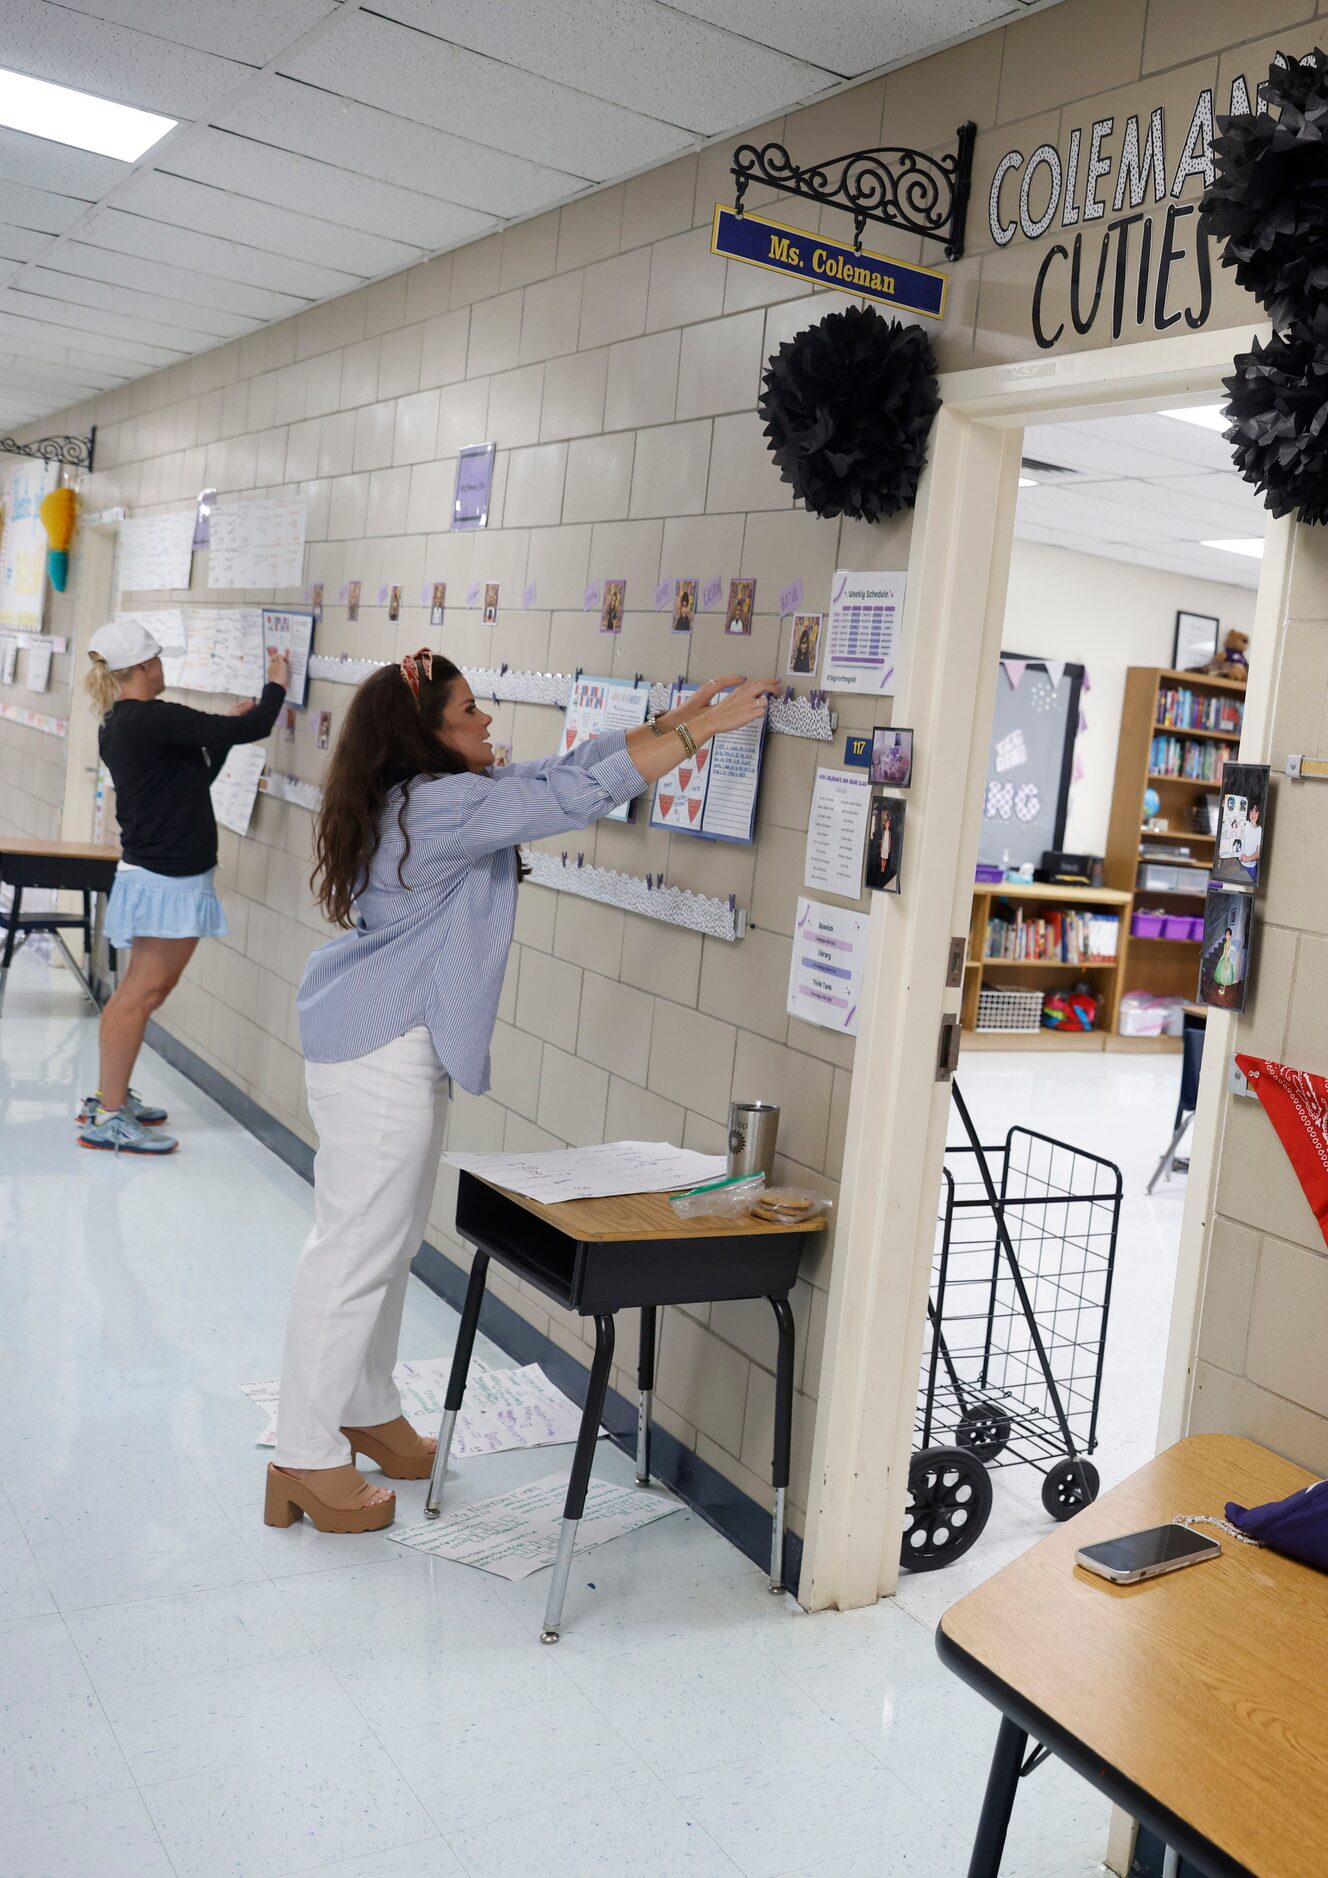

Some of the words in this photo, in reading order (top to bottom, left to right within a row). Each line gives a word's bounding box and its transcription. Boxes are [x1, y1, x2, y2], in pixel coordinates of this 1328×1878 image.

[768, 234, 804, 267] Ms.
[811, 248, 896, 295] Coleman
[1031, 204, 1213, 349] CUTIES
[848, 590, 866, 601] Weekly
[866, 589, 889, 600] Schedule
[853, 740, 866, 755] 117
[818, 922, 834, 933] Spanish
[818, 949, 832, 961] Library
[812, 978, 822, 988] Think
[822, 981, 832, 991] Tank
[738, 1121, 748, 1130] bp
